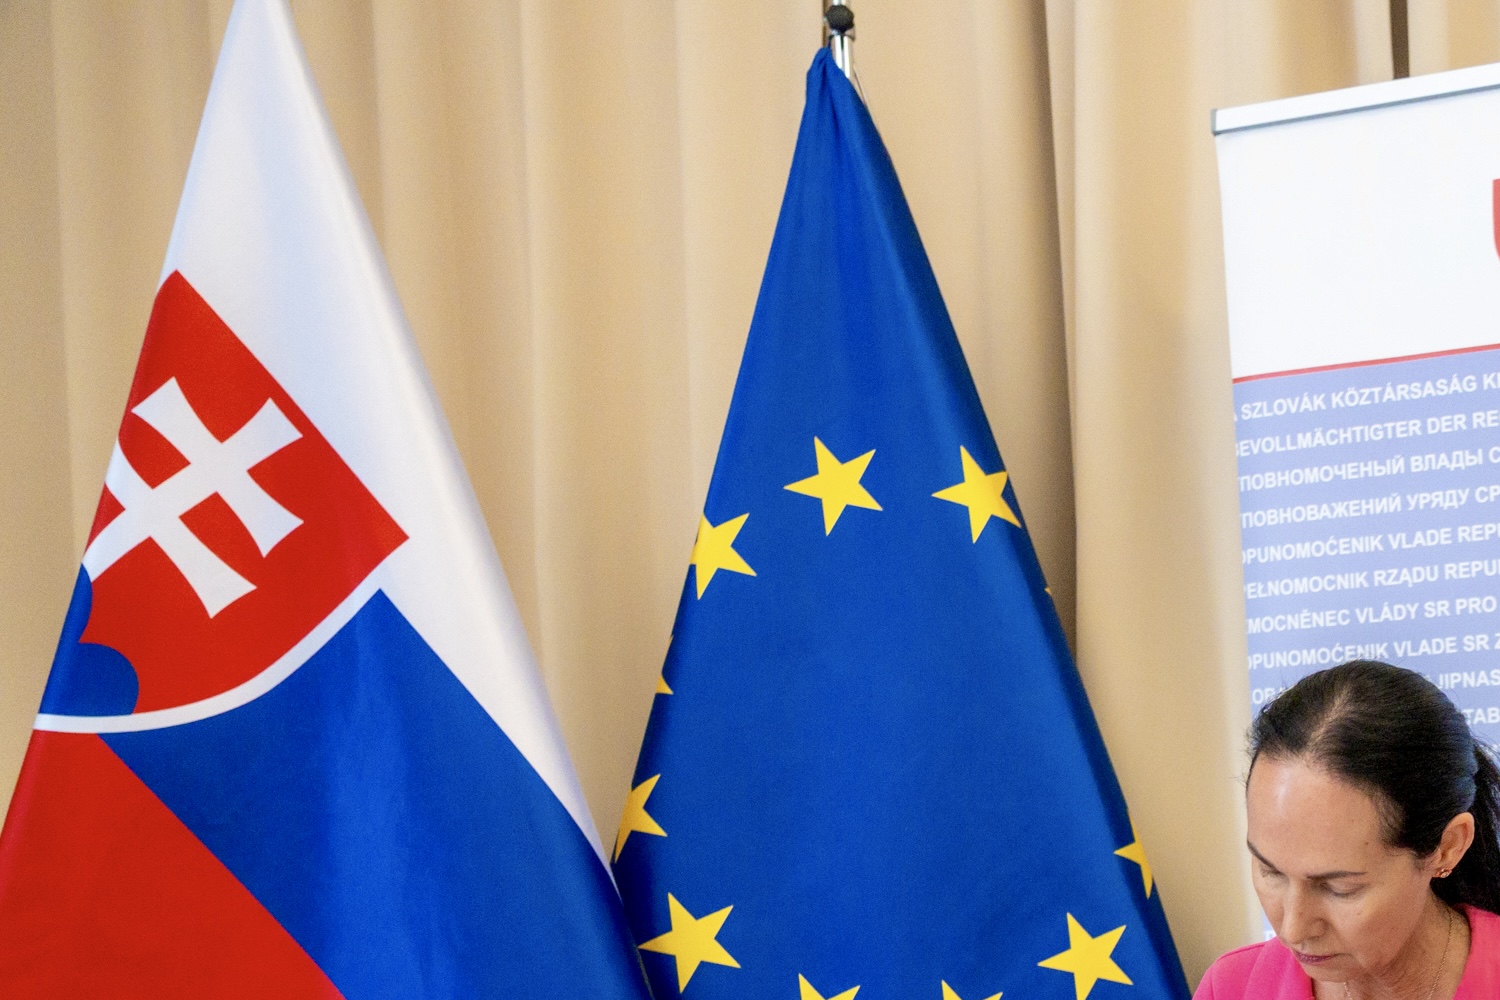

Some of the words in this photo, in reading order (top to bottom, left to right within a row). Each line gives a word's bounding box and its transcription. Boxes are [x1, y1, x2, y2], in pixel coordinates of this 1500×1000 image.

[1241, 392, 1326, 419] SZLOVÁK
[1331, 373, 1477, 408] KÖZTÁRSASÁG
[1236, 419, 1421, 456] EVOLLMÄCHTIGTER
[1426, 413, 1467, 434] DER
[1239, 454, 1405, 490] ПОВНОМОЧЕНЫЙ
[1410, 448, 1483, 472] ВЛАДЫ
[1241, 492, 1401, 527] ПОВНОВАЖЕНИЙ
[1406, 488, 1469, 511] УРЯДУ
[1387, 527, 1452, 549] VLADE
[1244, 571, 1369, 598] EŁNOMOCNIK
[1373, 565, 1438, 587] RZĄDU
[1247, 609, 1350, 632] MOCNĚNEC
[1355, 601, 1419, 623] VLÁDY
[1423, 600, 1450, 618] SR
[1455, 595, 1497, 615] PRO
[1393, 636, 1458, 657] VLADE
[1463, 634, 1489, 651] SR
